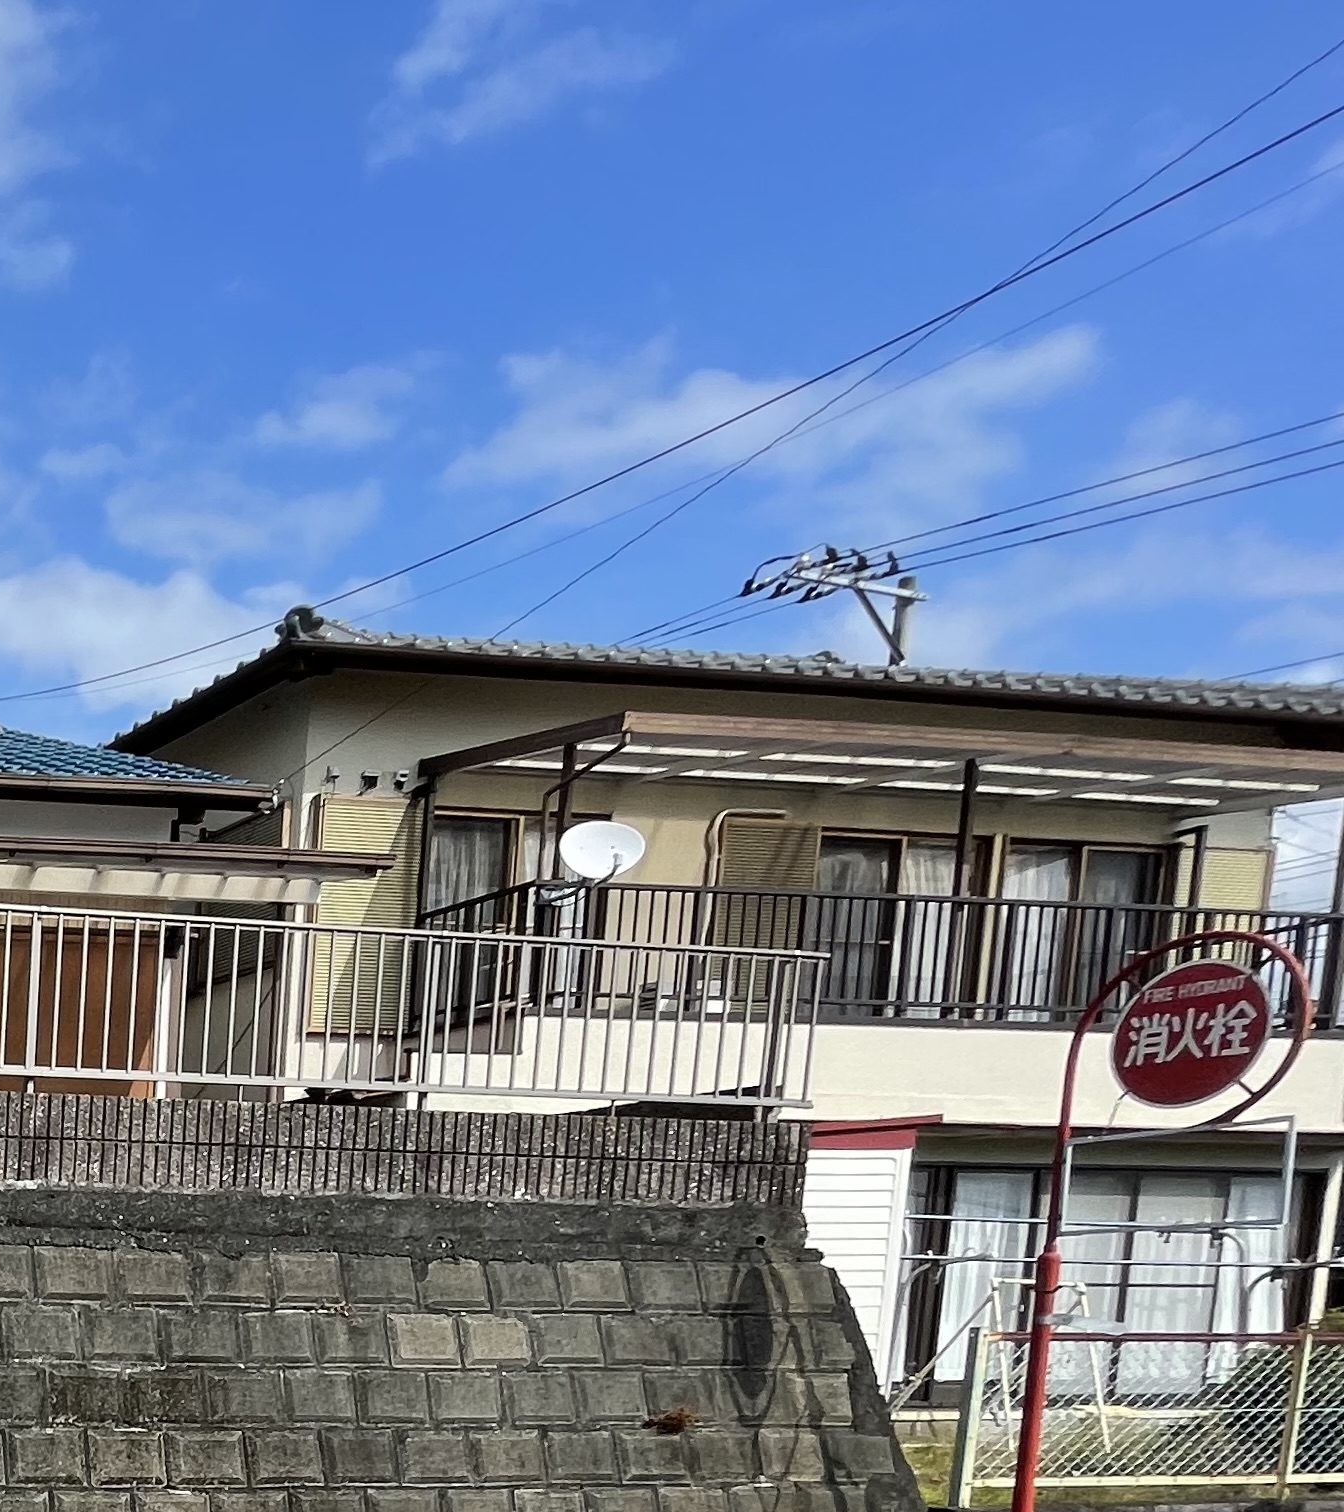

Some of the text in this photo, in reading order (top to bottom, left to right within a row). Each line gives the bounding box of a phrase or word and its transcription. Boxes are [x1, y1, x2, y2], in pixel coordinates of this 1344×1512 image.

[1143, 975, 1247, 1004] FIRE HYDRANT
[1123, 1000, 1257, 1068] 消火栓
